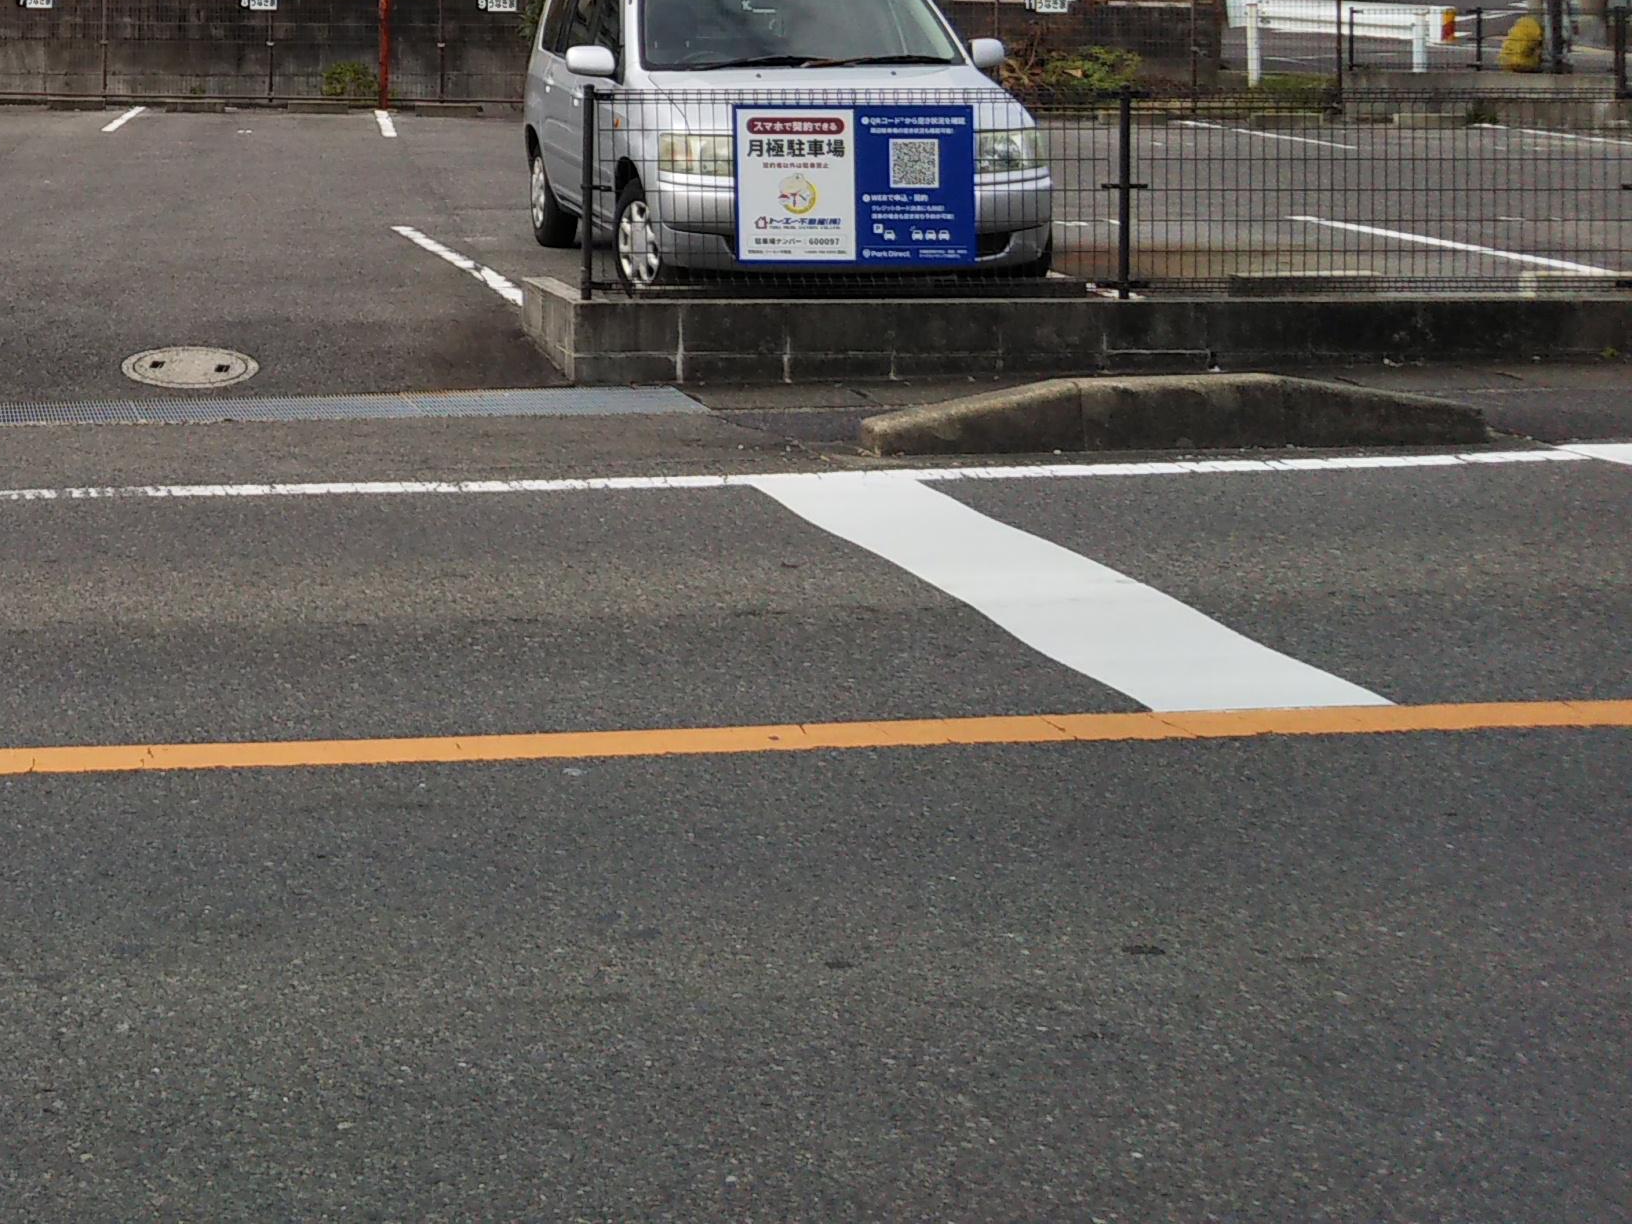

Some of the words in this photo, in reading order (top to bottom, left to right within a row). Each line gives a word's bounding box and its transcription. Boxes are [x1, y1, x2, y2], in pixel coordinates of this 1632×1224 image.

[753, 121, 838, 132] スマホで契約できる
[747, 139, 845, 157] 月極駐車場
